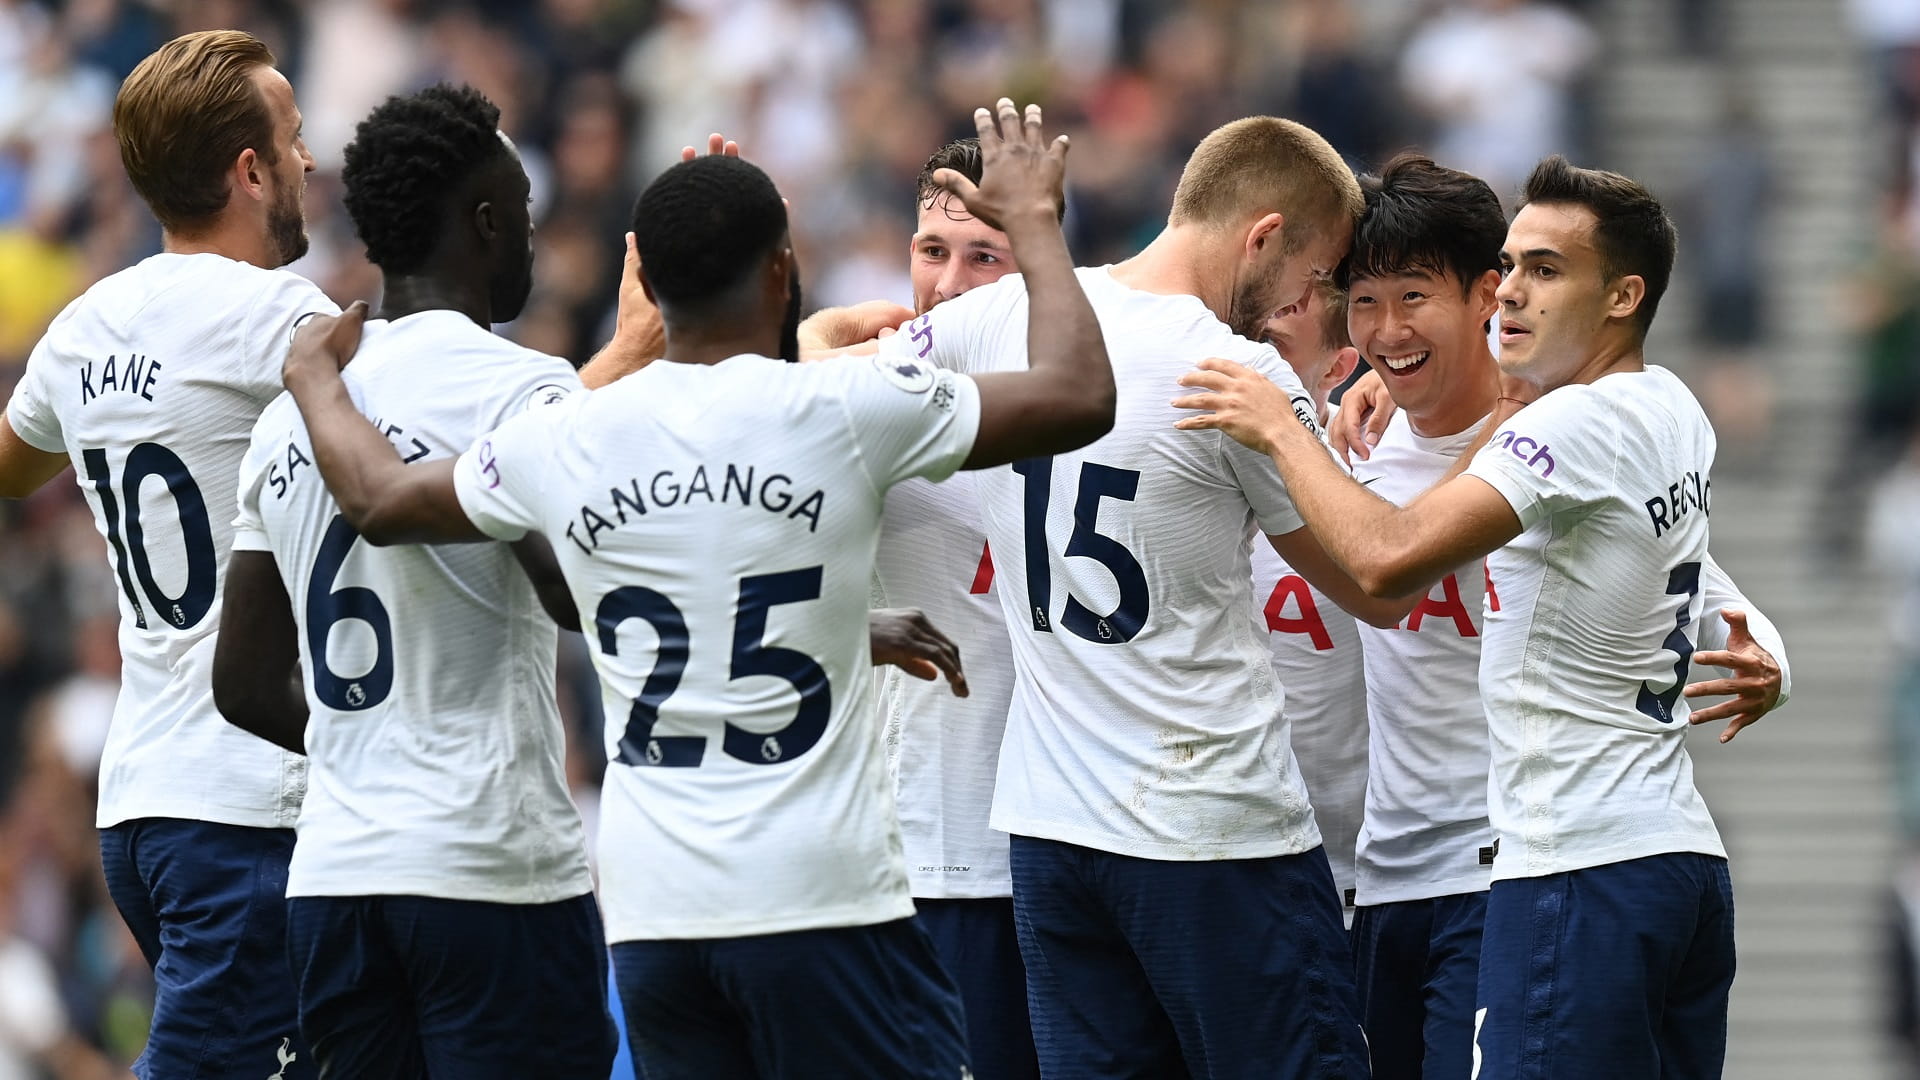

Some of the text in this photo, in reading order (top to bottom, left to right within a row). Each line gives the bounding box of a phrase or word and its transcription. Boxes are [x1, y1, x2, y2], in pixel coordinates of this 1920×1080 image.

[81, 354, 162, 405] KANE
[82, 442, 216, 630] 10
[566, 463, 827, 556] TANGANGA
[1011, 456, 1150, 645] 15
[307, 513, 394, 712] 6
[594, 565, 832, 768] 25
[1636, 562, 1701, 723] 3
